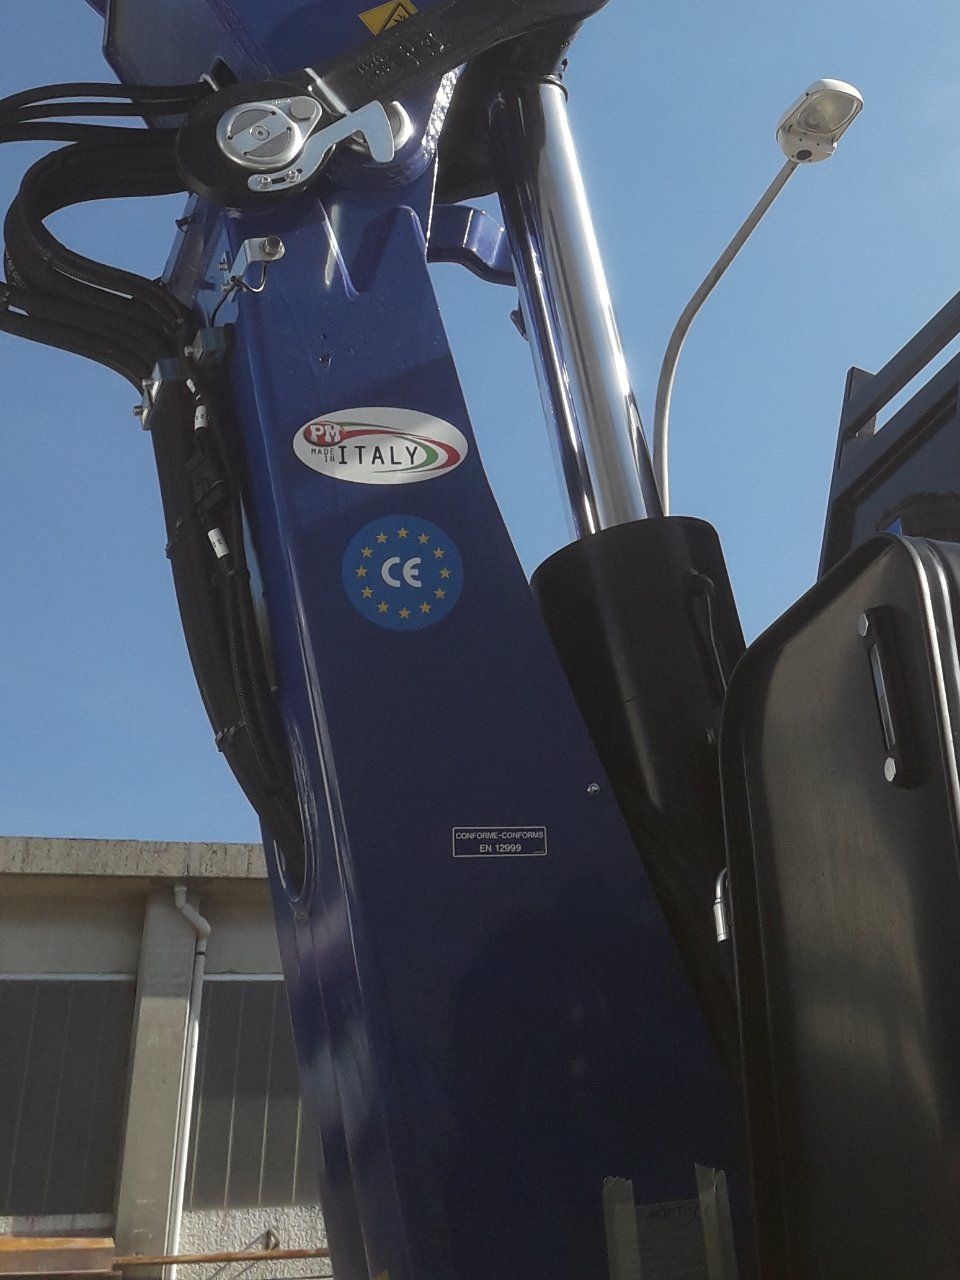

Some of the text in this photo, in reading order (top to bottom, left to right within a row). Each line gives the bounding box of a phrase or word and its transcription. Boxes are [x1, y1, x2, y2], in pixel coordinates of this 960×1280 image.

[309, 424, 341, 443] PM
[311, 448, 335, 456] MADE
[324, 455, 335, 463] IN
[338, 445, 419, 465] ITALY
[381, 556, 422, 588] CE
[479, 843, 522, 852] EN 12999
